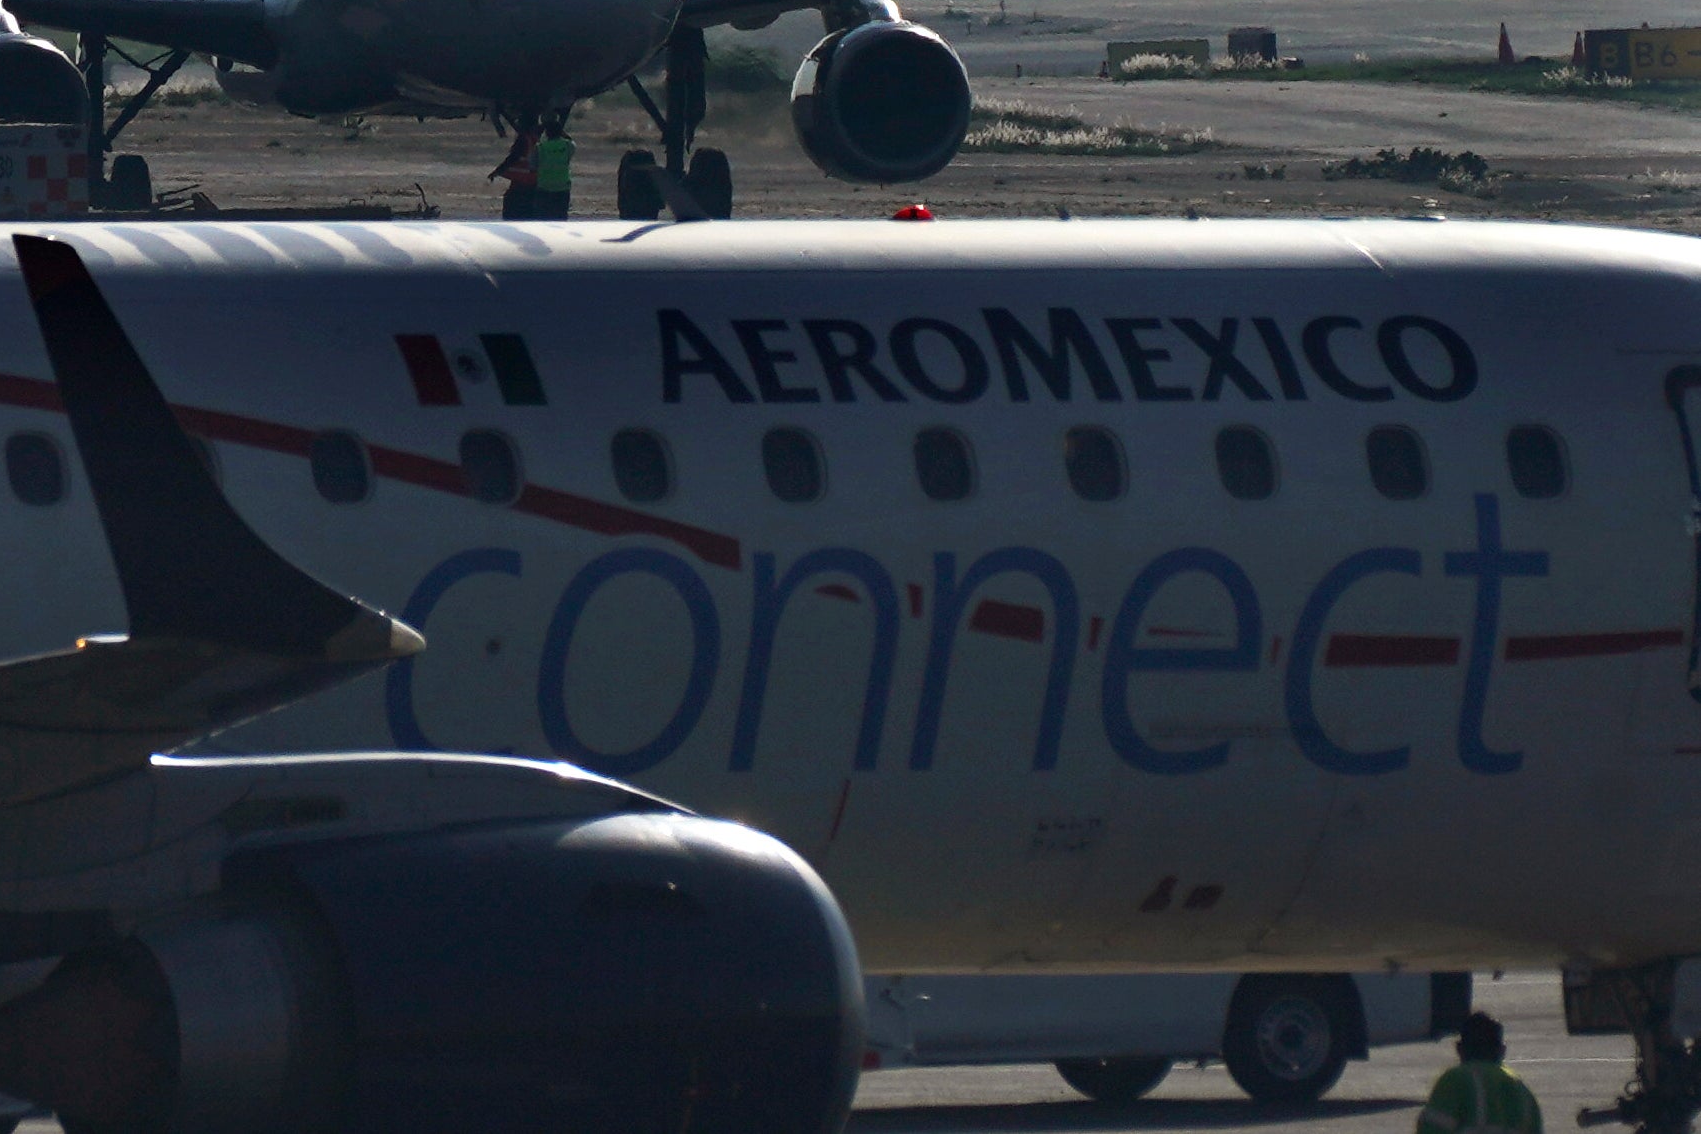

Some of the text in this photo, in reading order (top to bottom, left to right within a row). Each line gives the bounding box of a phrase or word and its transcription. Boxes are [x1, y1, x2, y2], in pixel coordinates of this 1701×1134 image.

[1599, 41, 1678, 68] B B6
[656, 307, 1479, 404] AEROMEXICO
[385, 493, 1550, 777] connect
